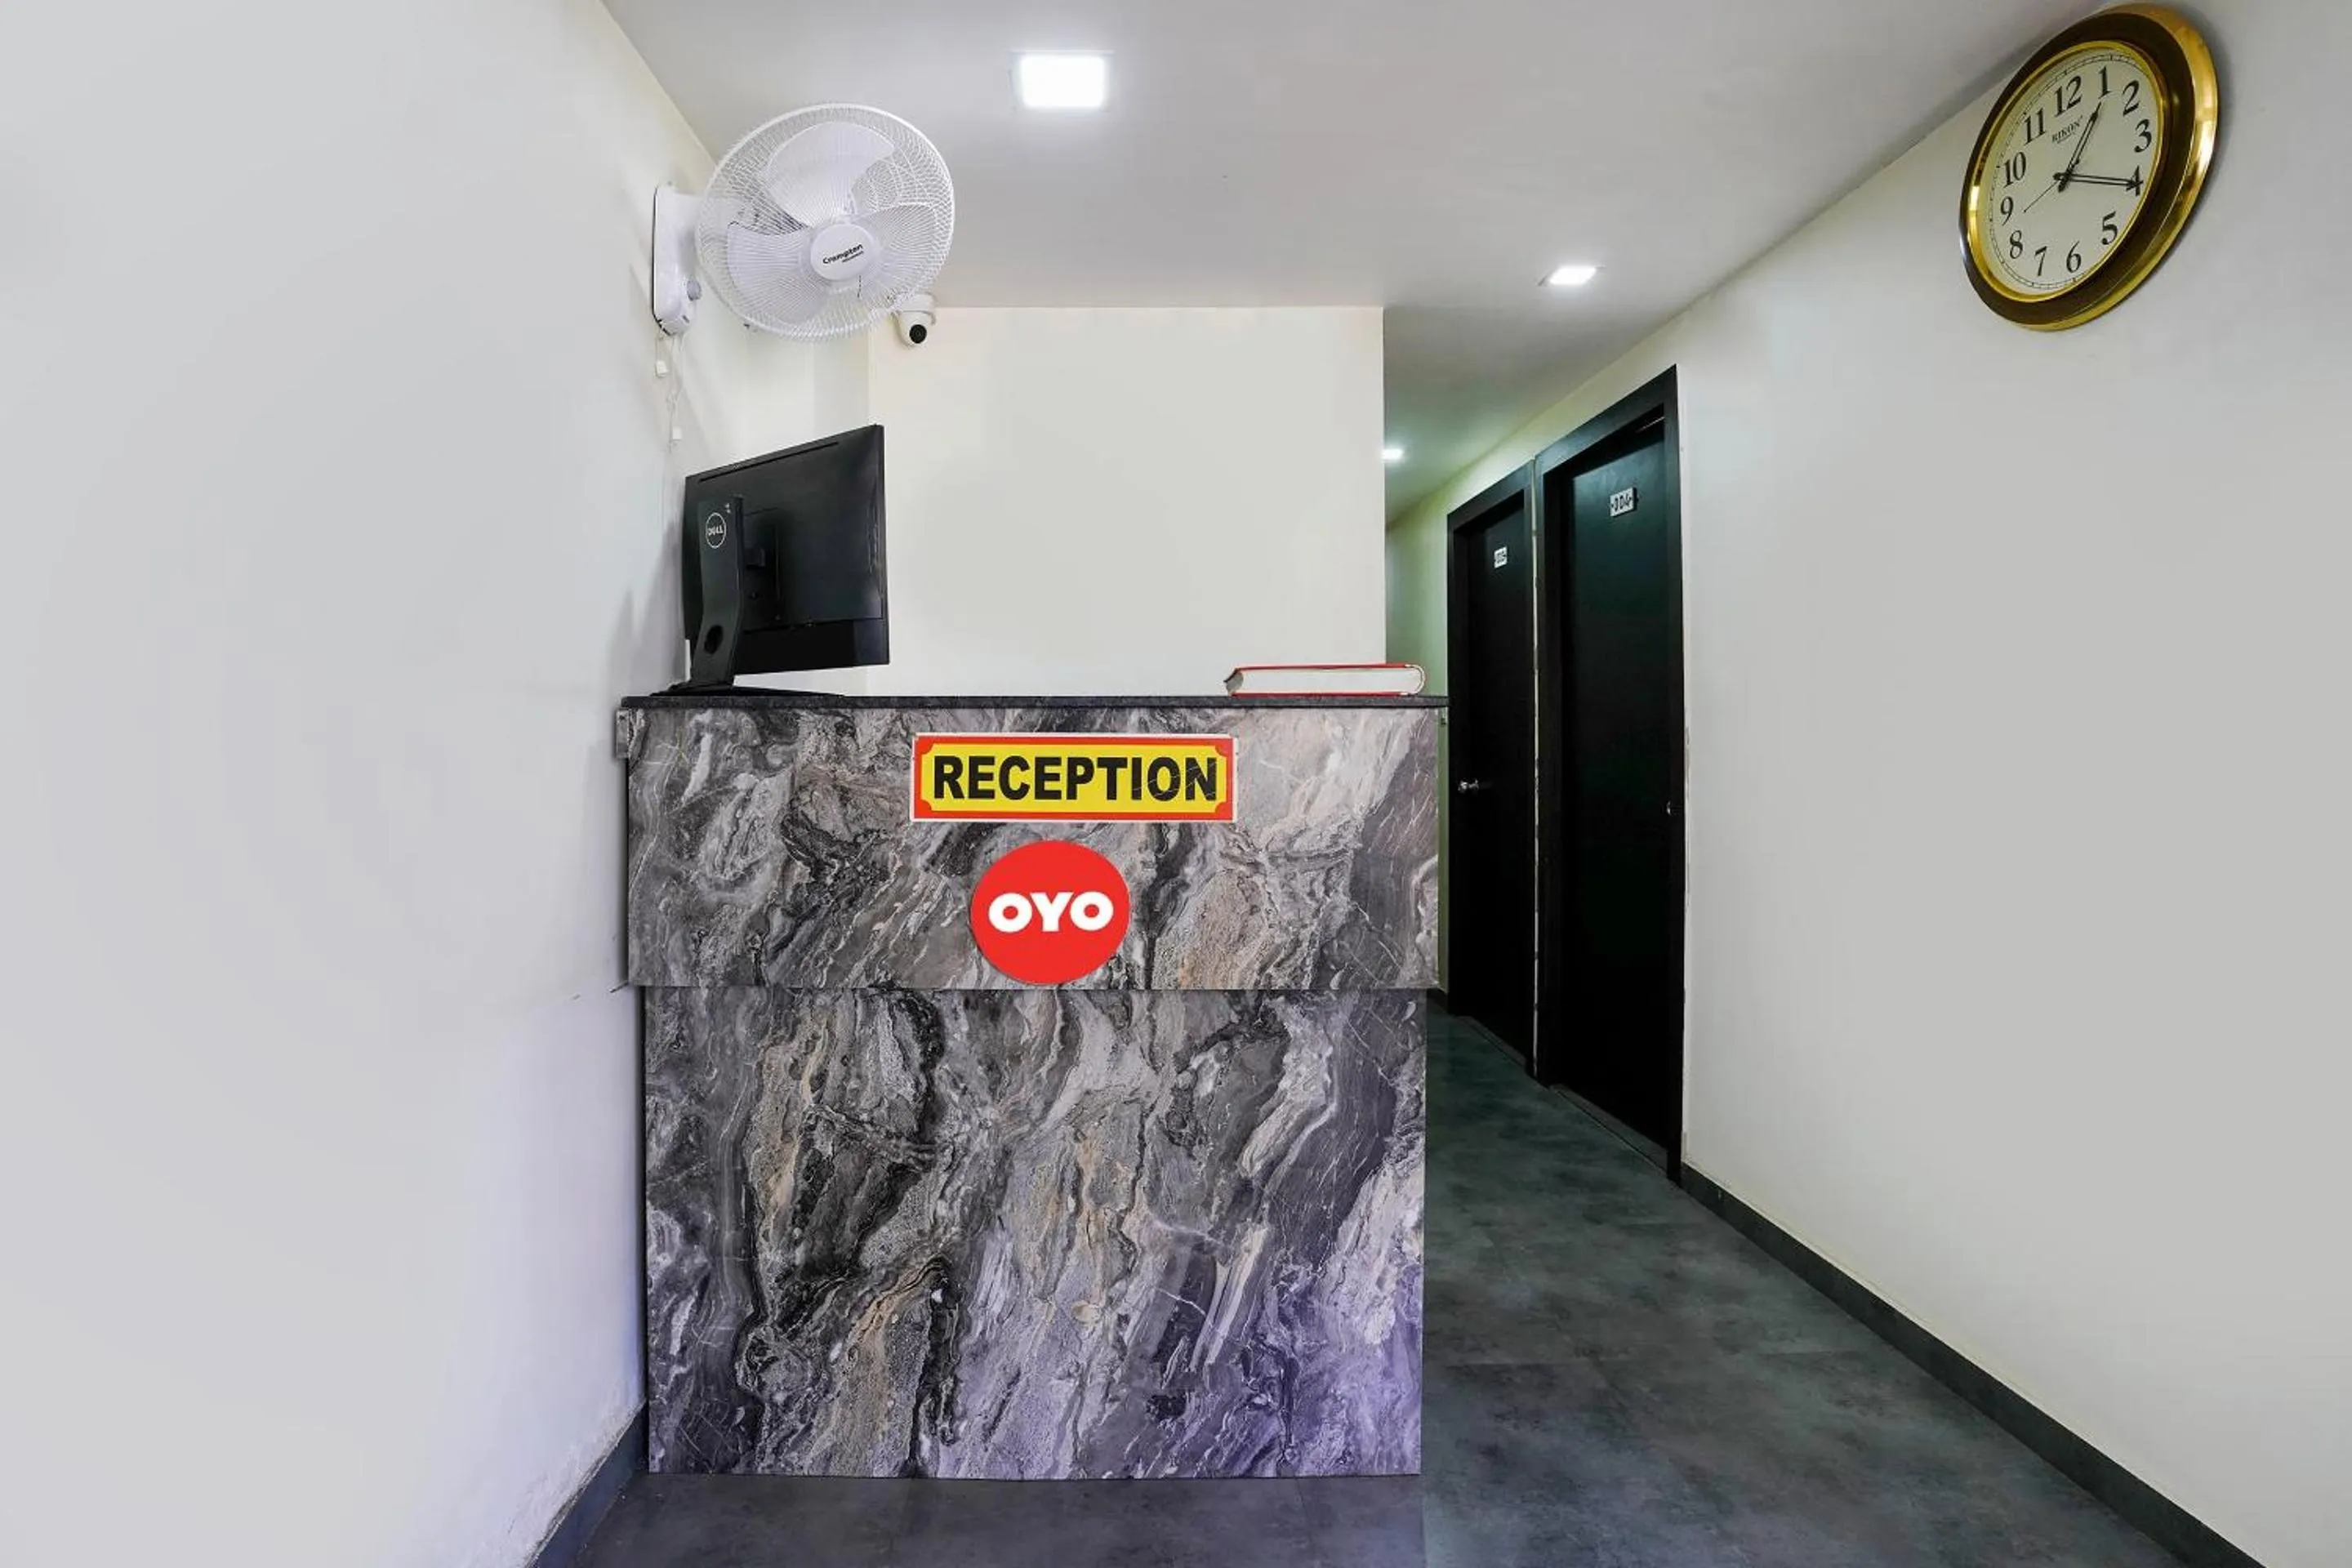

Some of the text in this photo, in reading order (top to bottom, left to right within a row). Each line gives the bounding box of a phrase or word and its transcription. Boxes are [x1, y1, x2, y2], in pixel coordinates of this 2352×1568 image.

[2054, 75, 2082, 118] 12
[2099, 66, 2110, 98] 1
[2123, 80, 2140, 116] 2
[2024, 107, 2047, 145] 11
[2134, 118, 2152, 153] 3
[2004, 151, 2026, 188] 10
[2126, 164, 2144, 197] 4
[2000, 196, 2014, 226] 9
[2009, 229, 2024, 260] 8
[2101, 212, 2118, 246] 5
[2034, 246, 2047, 277] 7
[2066, 240, 2082, 274] 6
[933, 755, 1218, 802] RECEPTION
[988, 891, 1114, 933] OYO
